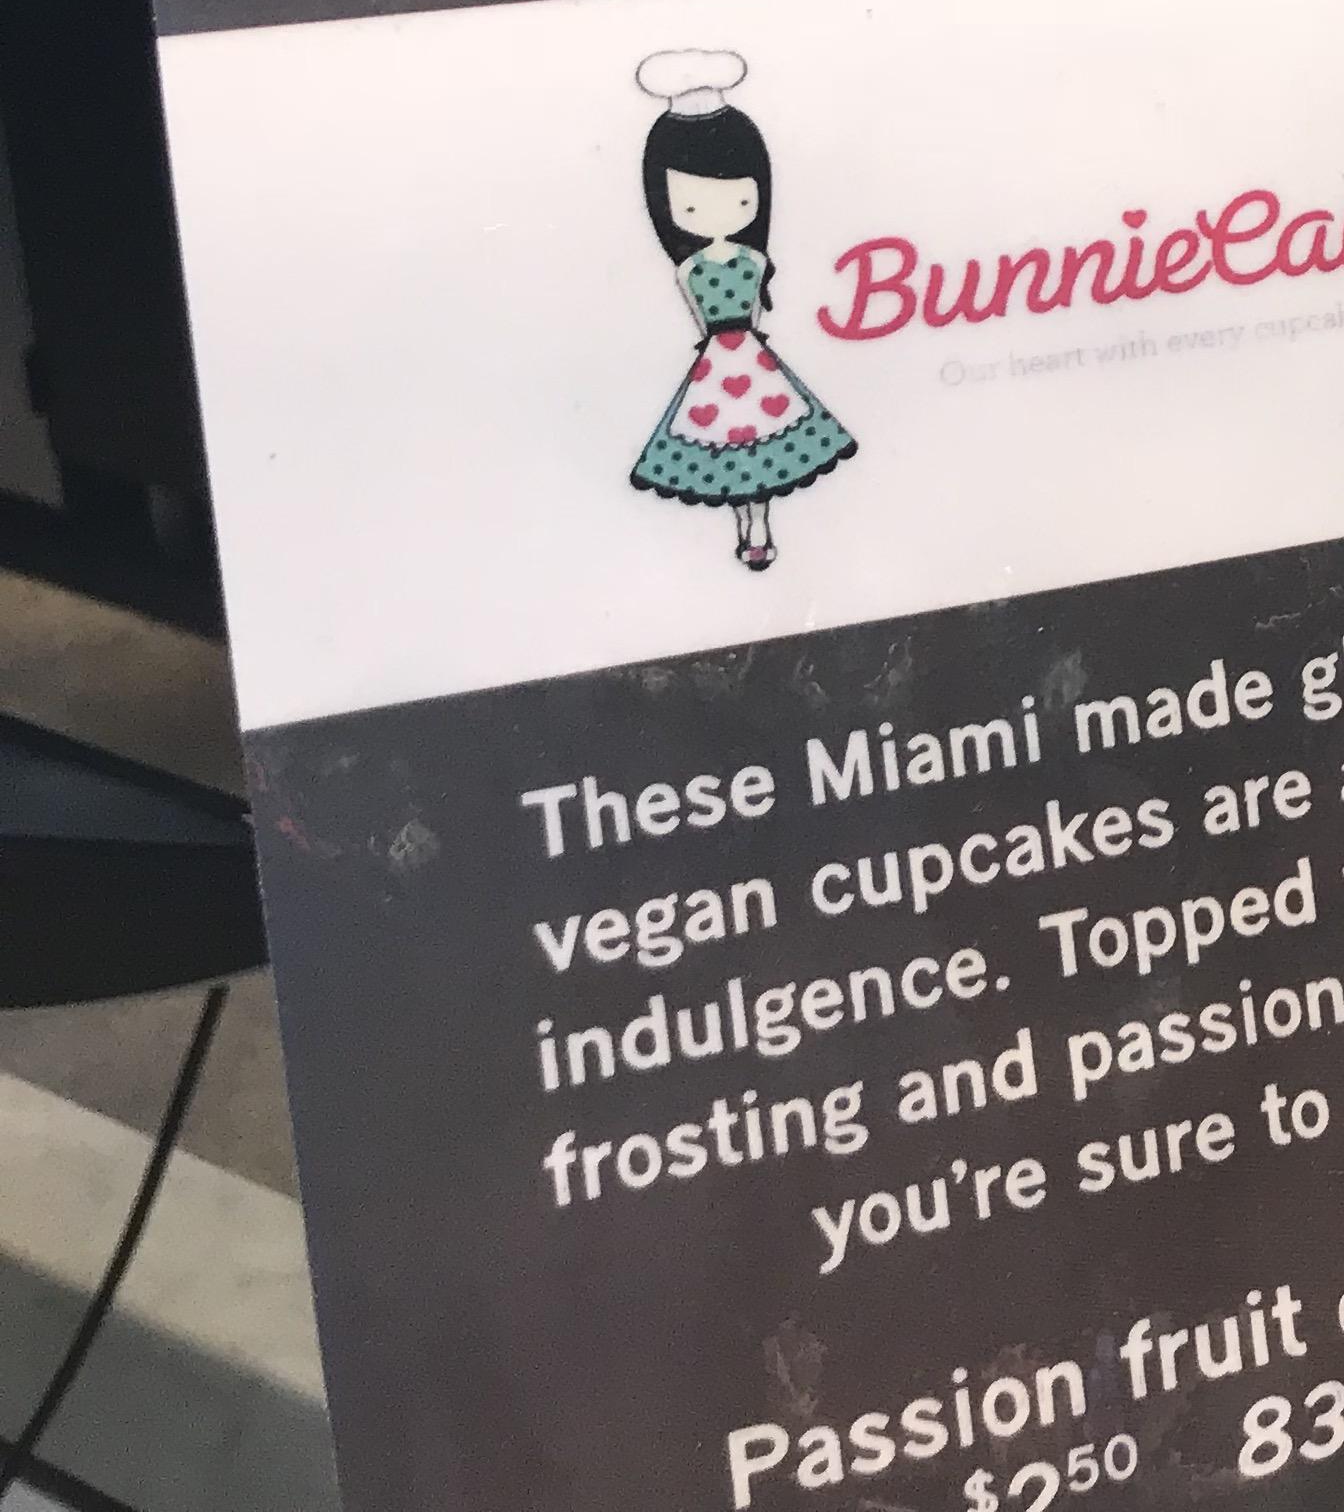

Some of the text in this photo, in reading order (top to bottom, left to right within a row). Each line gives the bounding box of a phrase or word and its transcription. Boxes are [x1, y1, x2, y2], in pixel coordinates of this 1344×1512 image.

[938, 358, 1000, 387] Our
[1009, 348, 1086, 378] heart
[1095, 330, 1159, 362] with
[1166, 323, 1246, 356] every
[521, 764, 777, 858] These
[805, 694, 1042, 806] Miami
[1073, 659, 1274, 753] made
[533, 876, 777, 972] vegan
[810, 799, 1175, 915] cupcakes
[1203, 768, 1312, 836] are
[536, 947, 1011, 1090] indulgence.
[1038, 857, 1318, 978] Topped
[543, 1080, 869, 1207] frosting
[898, 1027, 1038, 1123] and
[811, 1156, 1046, 1275] you're
[1077, 1112, 1236, 1192] sure
[1260, 1083, 1330, 1145] to
[727, 1359, 1087, 1511] Passion
[1119, 1284, 1308, 1399] fruit
